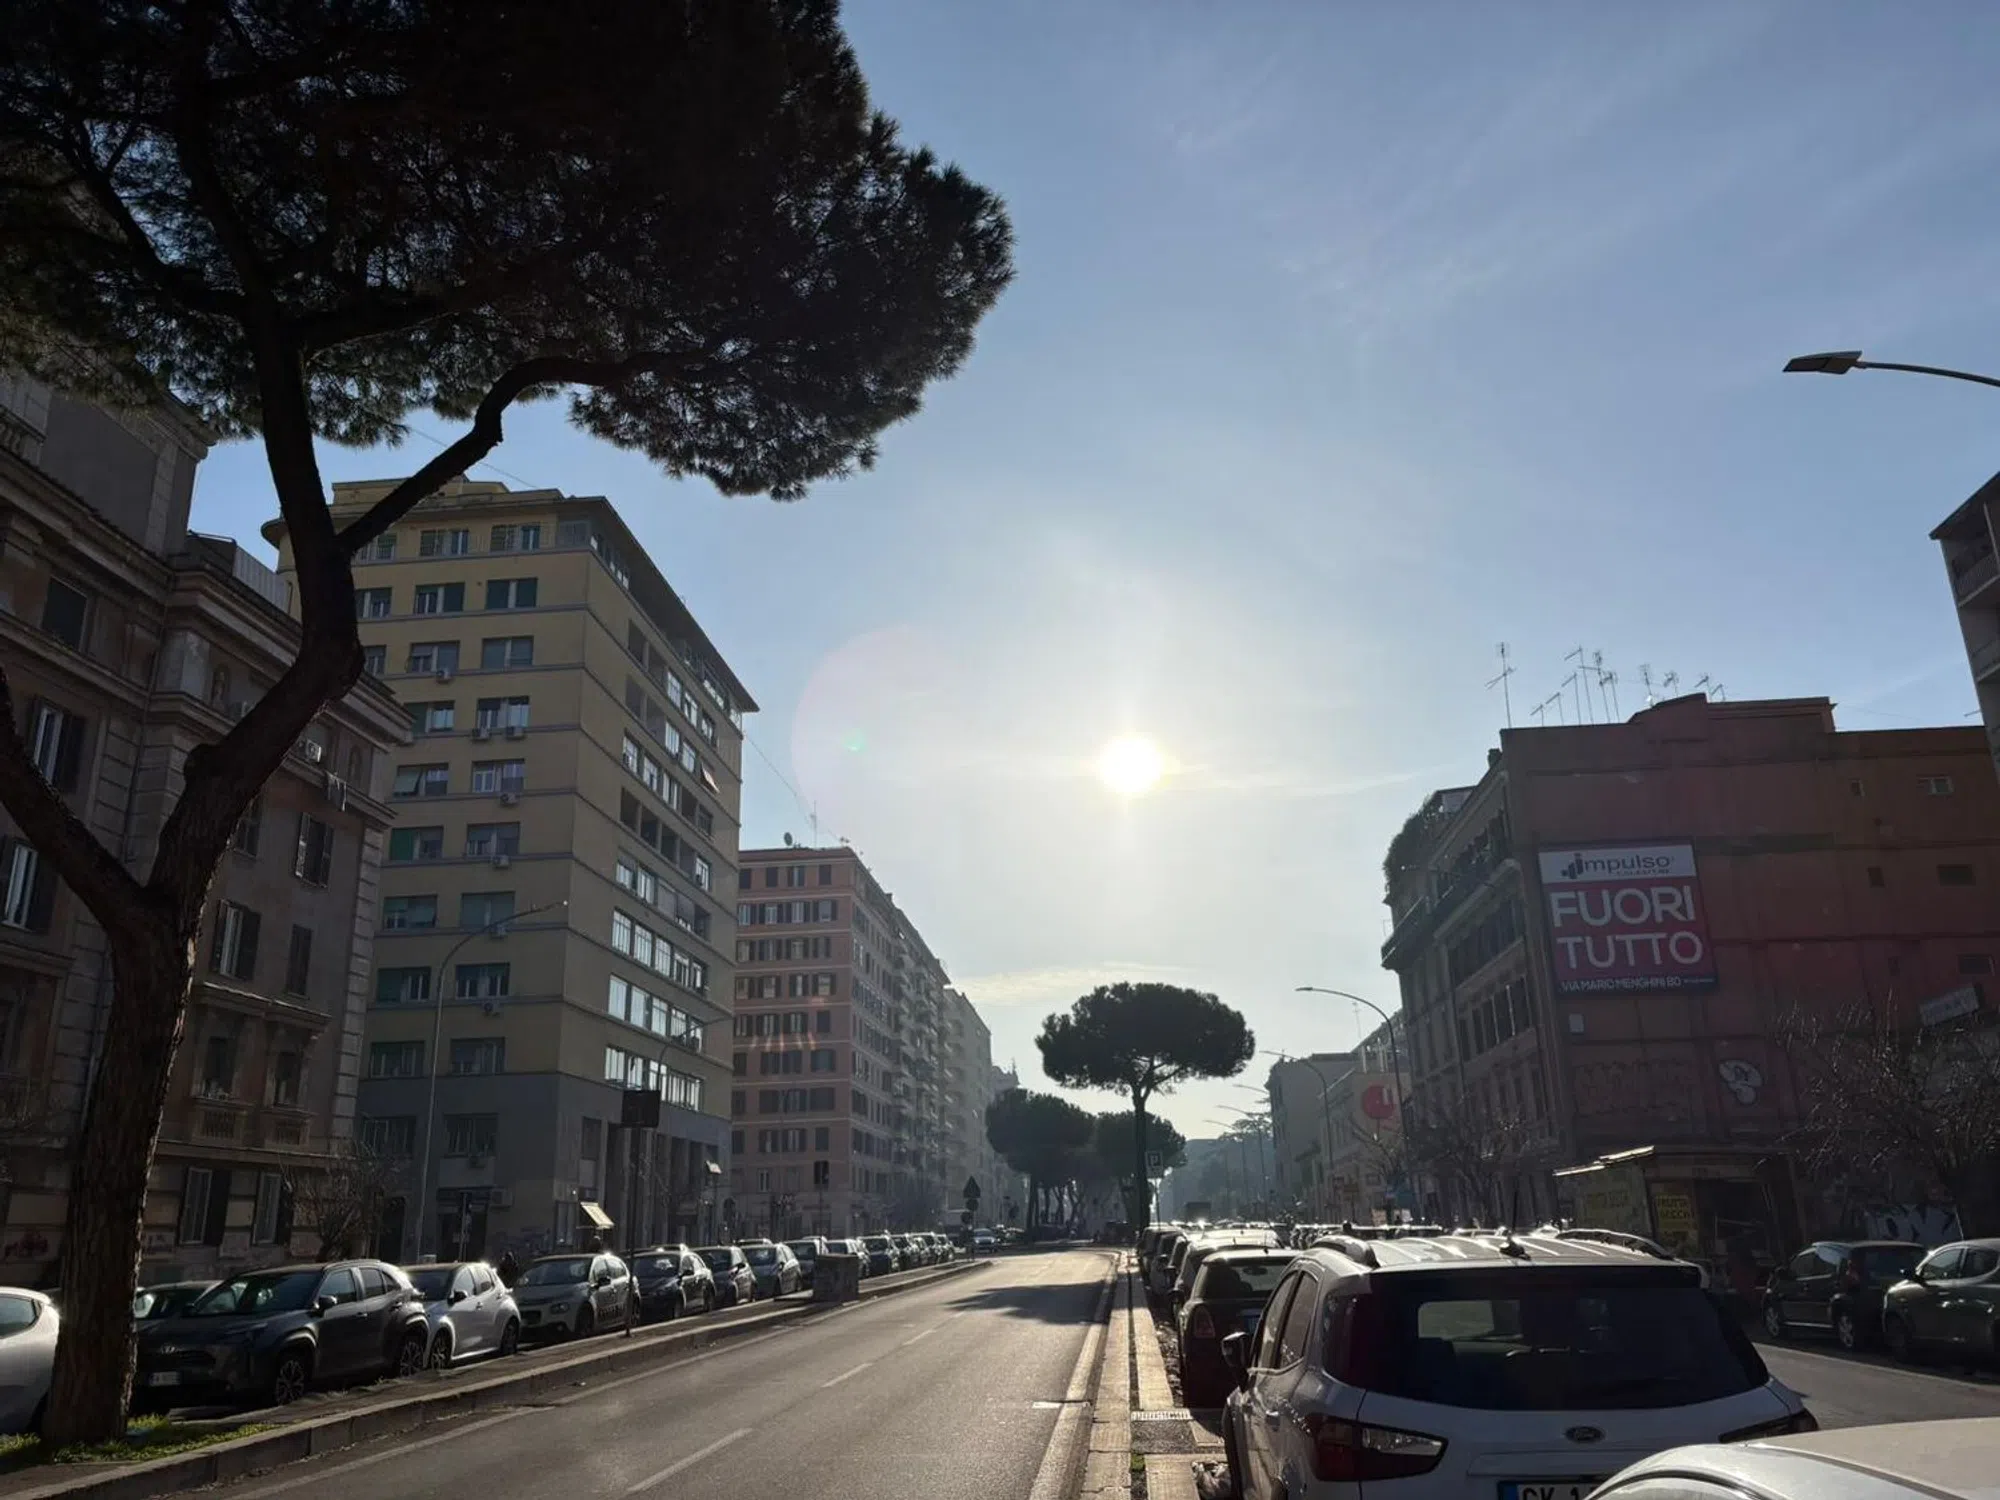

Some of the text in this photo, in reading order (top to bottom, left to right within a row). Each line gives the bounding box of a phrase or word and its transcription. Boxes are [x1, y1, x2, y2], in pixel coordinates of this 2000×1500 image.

[1574, 853, 1670, 876] impulso
[1549, 885, 1696, 928] FUORI
[1556, 931, 1703, 969] TUTTO
[1561, 979, 1580, 993] VIA
